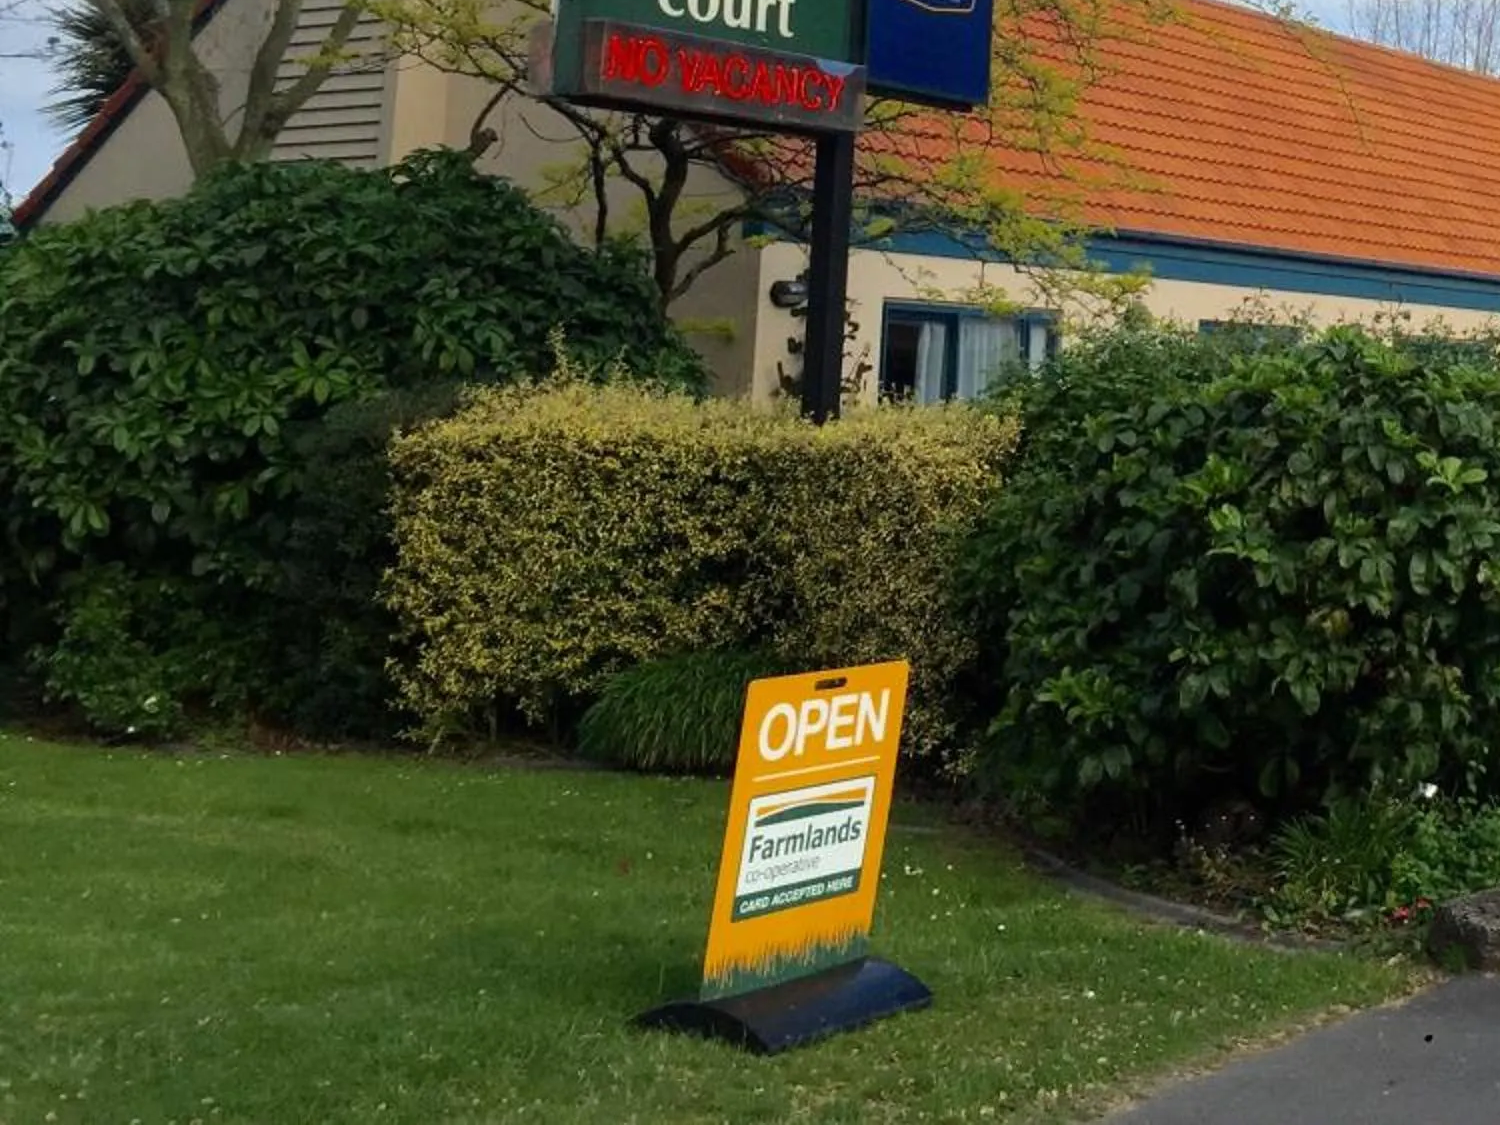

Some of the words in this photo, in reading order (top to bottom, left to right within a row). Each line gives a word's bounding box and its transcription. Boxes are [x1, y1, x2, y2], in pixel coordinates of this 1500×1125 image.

[605, 33, 670, 88] NO
[677, 47, 846, 112] VACANCY
[759, 687, 891, 762] OPEN
[748, 815, 862, 864] Farmlands
[739, 895, 771, 914] CARD
[770, 881, 826, 906] ACCEPTED
[826, 875, 855, 893] HERE
